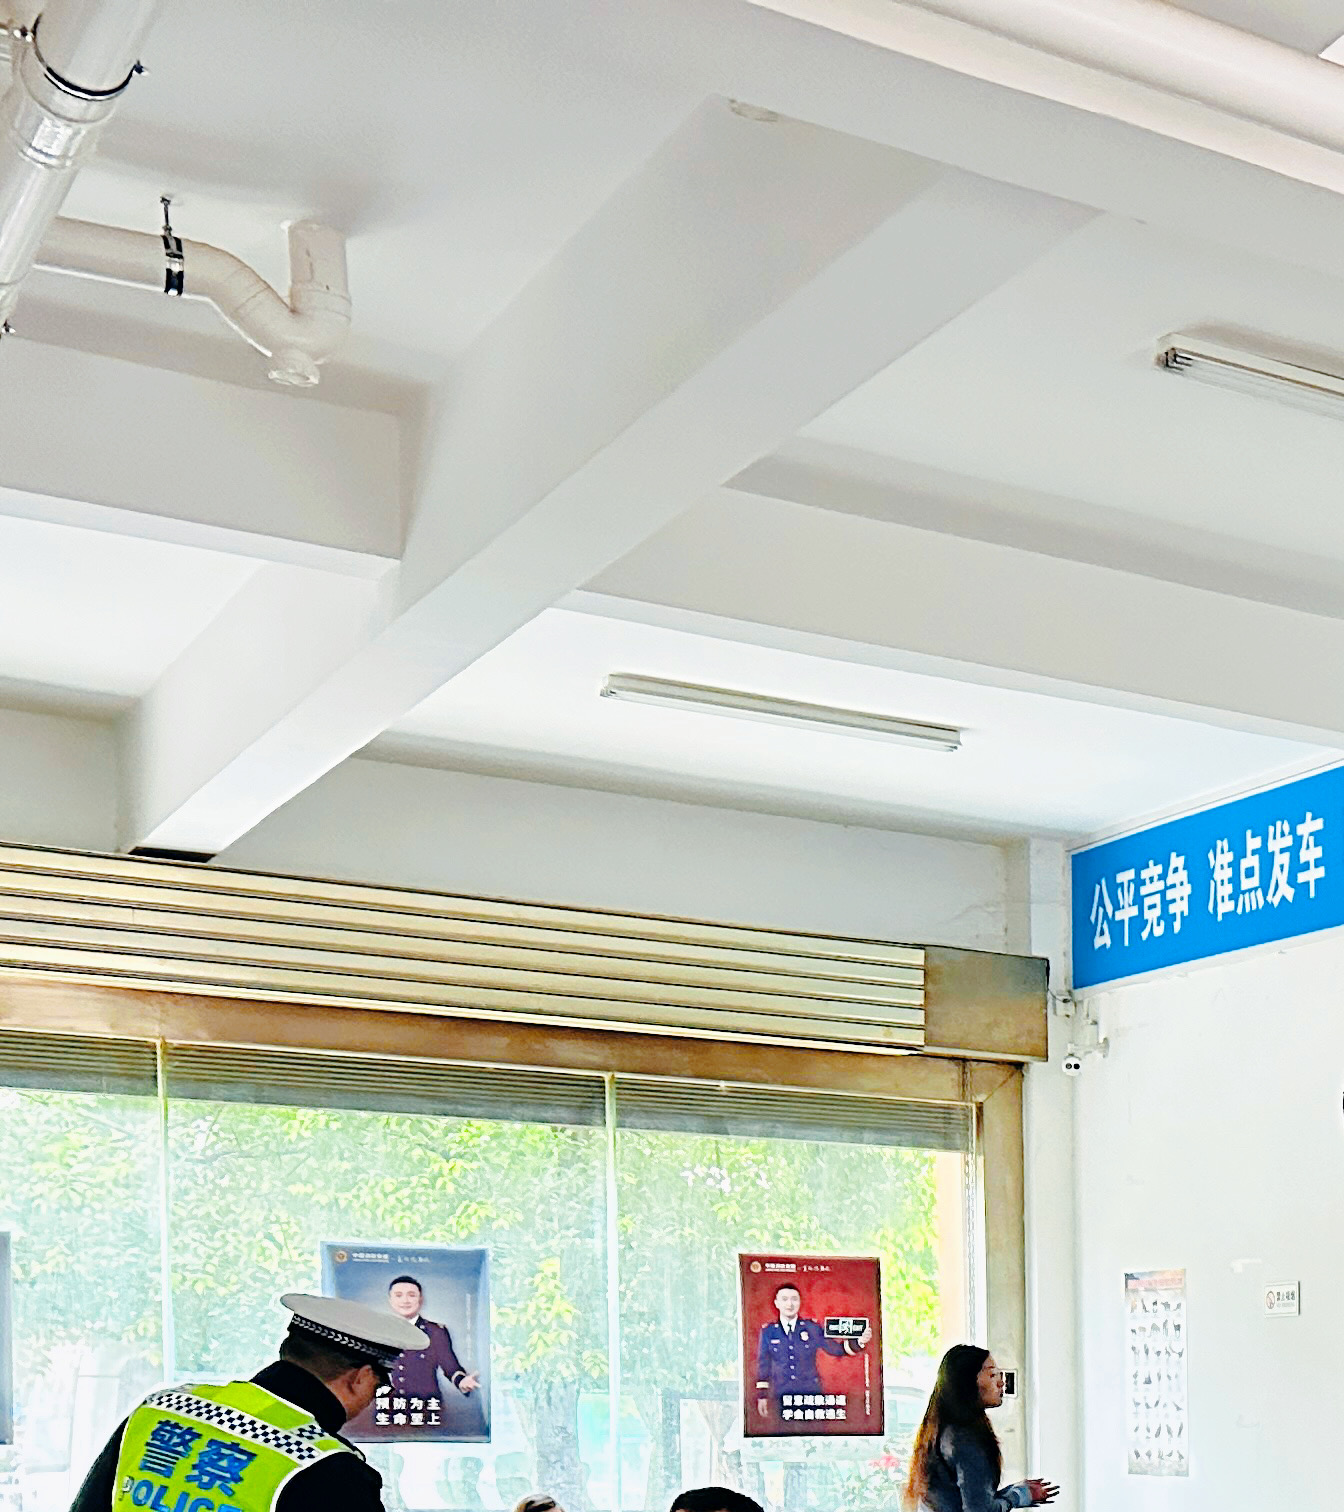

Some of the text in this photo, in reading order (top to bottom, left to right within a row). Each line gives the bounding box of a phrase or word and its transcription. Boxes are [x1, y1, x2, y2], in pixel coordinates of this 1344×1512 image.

[1089, 852, 1192, 951] 公平竞争
[1207, 811, 1325, 922] 准点发车
[376, 1397, 441, 1411] 预防为主
[376, 1412, 441, 1426] 生命至上
[138, 1419, 258, 1497] 警察
